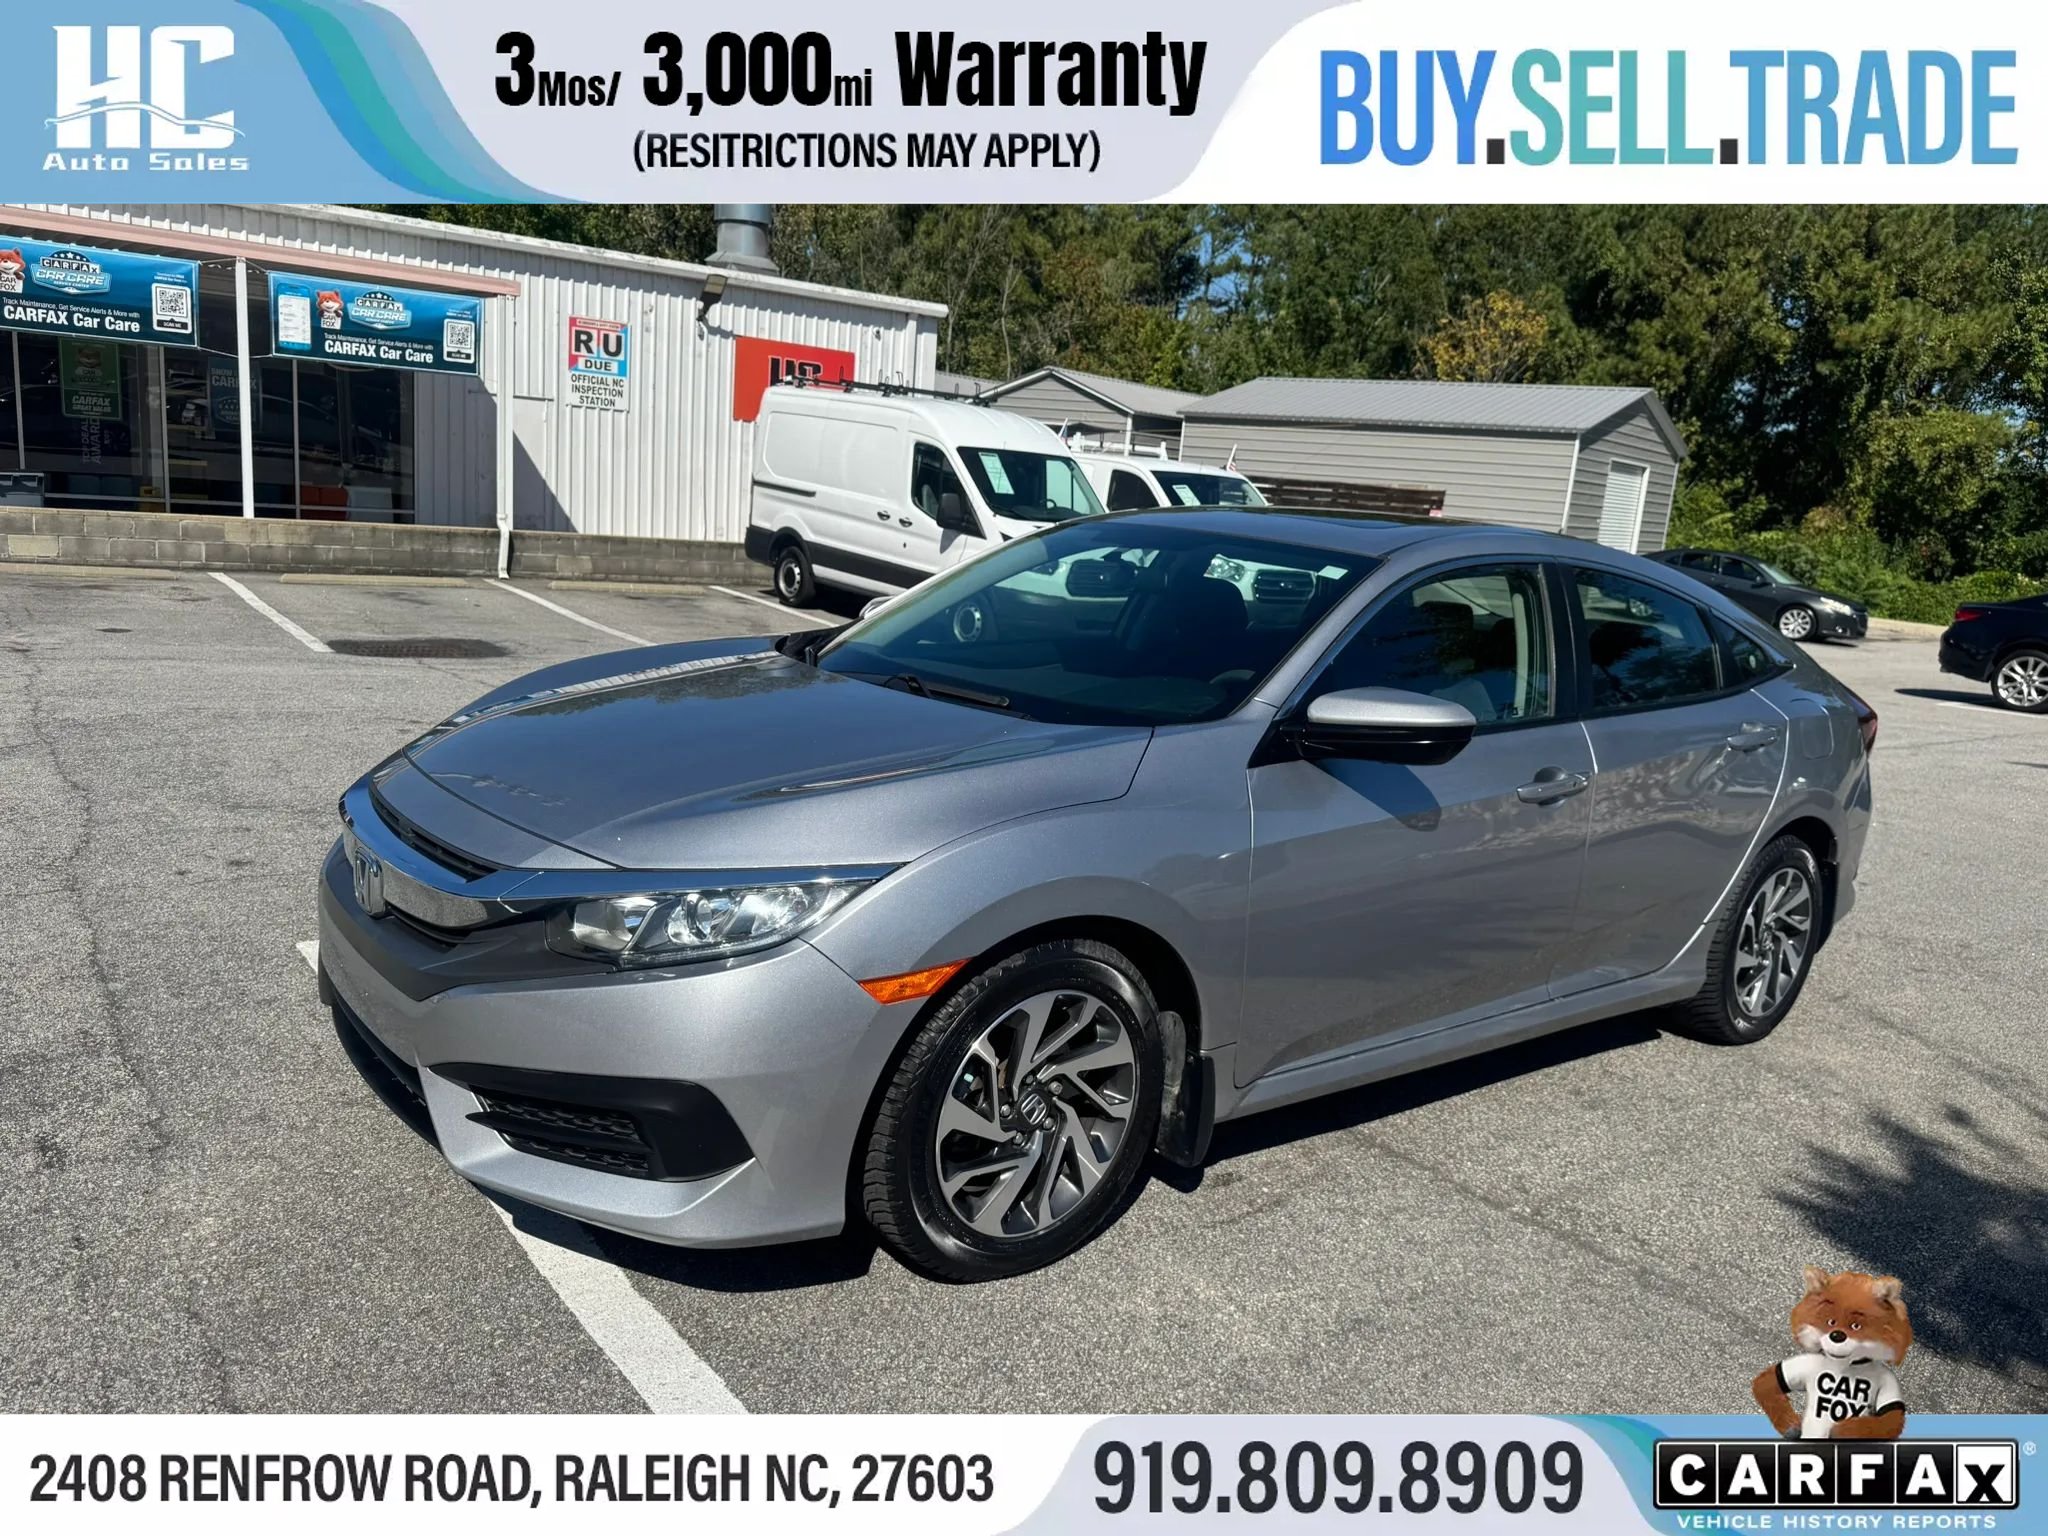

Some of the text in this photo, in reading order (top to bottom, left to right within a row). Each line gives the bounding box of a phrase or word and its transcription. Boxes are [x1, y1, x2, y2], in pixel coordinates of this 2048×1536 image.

[42, 259, 99, 274] CARFAX
[36, 268, 105, 285] CAR CARE
[3, 297, 18, 305] Track
[20, 299, 58, 310] Maintenance,
[70, 304, 90, 313] Service
[91, 306, 107, 315] Alerts
[113, 309, 128, 317] More
[356, 298, 403, 311] CARFAX
[3, 305, 140, 333] CARFAX Car Care
[351, 307, 375, 318] CAR
[375, 309, 407, 322] CARE
[324, 339, 434, 363] CARFAX Car Care
[584, 359, 613, 372] DUE
[211, 375, 257, 390] CARX
[570, 373, 625, 389] OFFICIAL NC
[571, 383, 624, 399] INSPECTION
[71, 395, 112, 407] CARFAX
[579, 395, 616, 408] STATION
